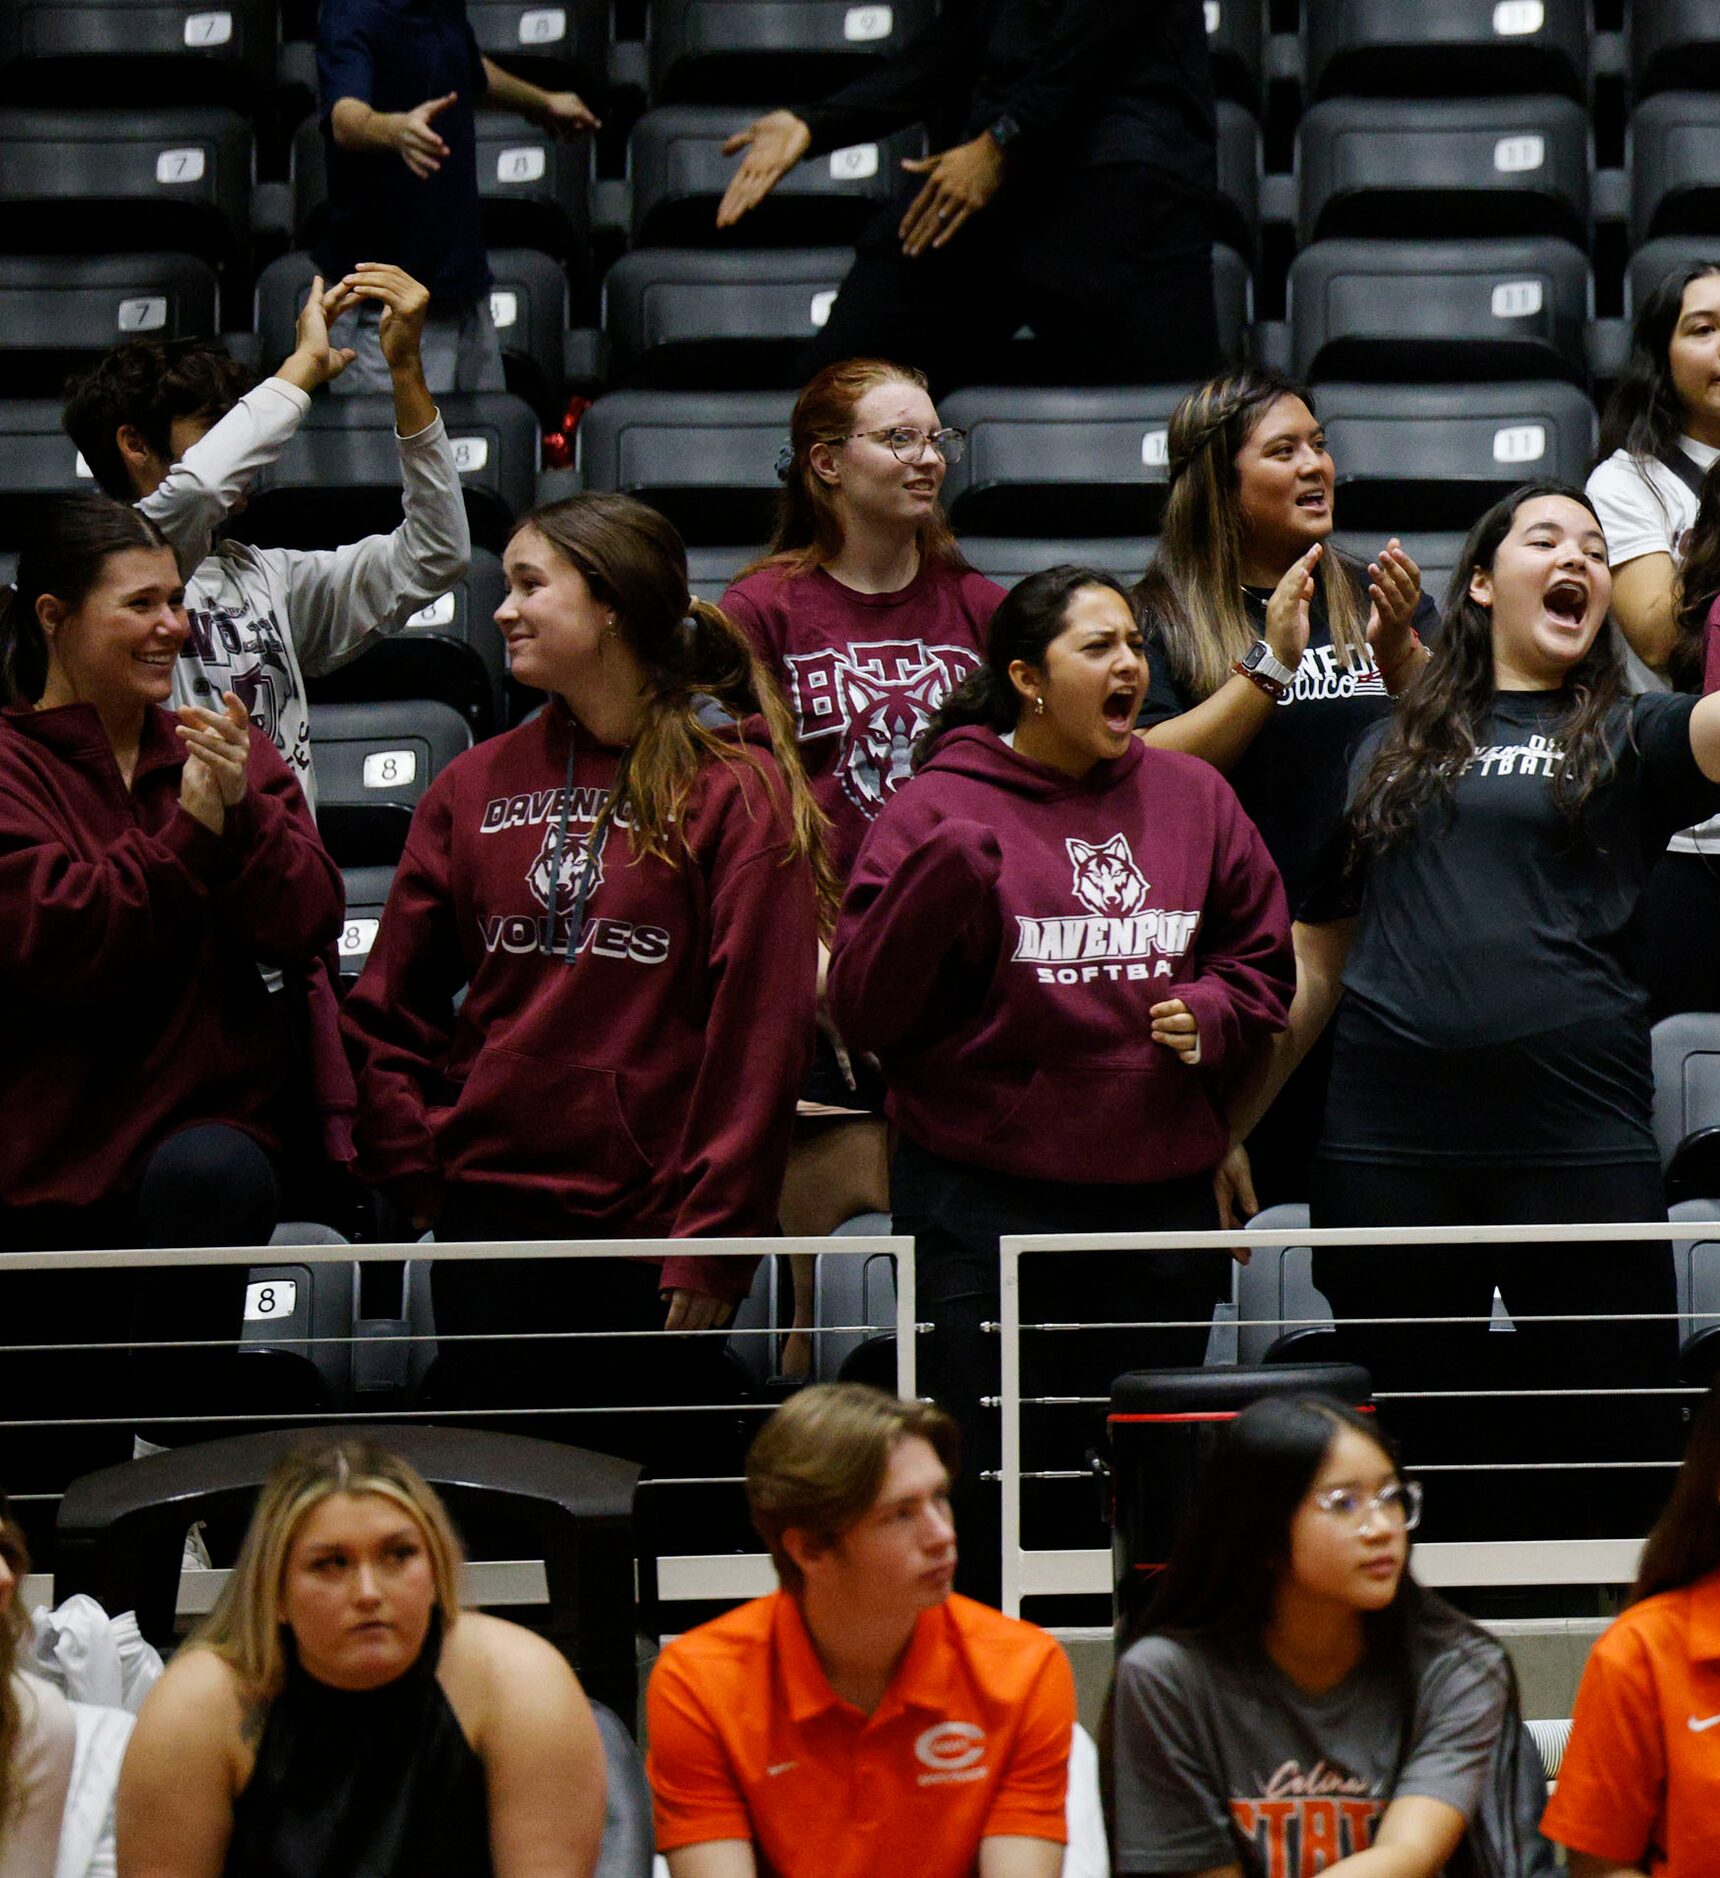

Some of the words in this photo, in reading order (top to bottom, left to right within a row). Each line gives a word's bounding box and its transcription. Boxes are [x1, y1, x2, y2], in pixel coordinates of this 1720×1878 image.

[202, 21, 215, 41] 7
[534, 19, 549, 37] 8
[175, 155, 188, 176] 7
[1507, 144, 1530, 165] 11
[514, 156, 528, 178] 8
[1506, 289, 1530, 312] 11
[136, 304, 150, 325] 7
[456, 444, 470, 467] 8
[1507, 433, 1531, 456] 11
[421, 601, 438, 623] 8
[381, 757, 398, 781] 8
[344, 925, 363, 950] 8
[258, 1287, 276, 1315] 8
